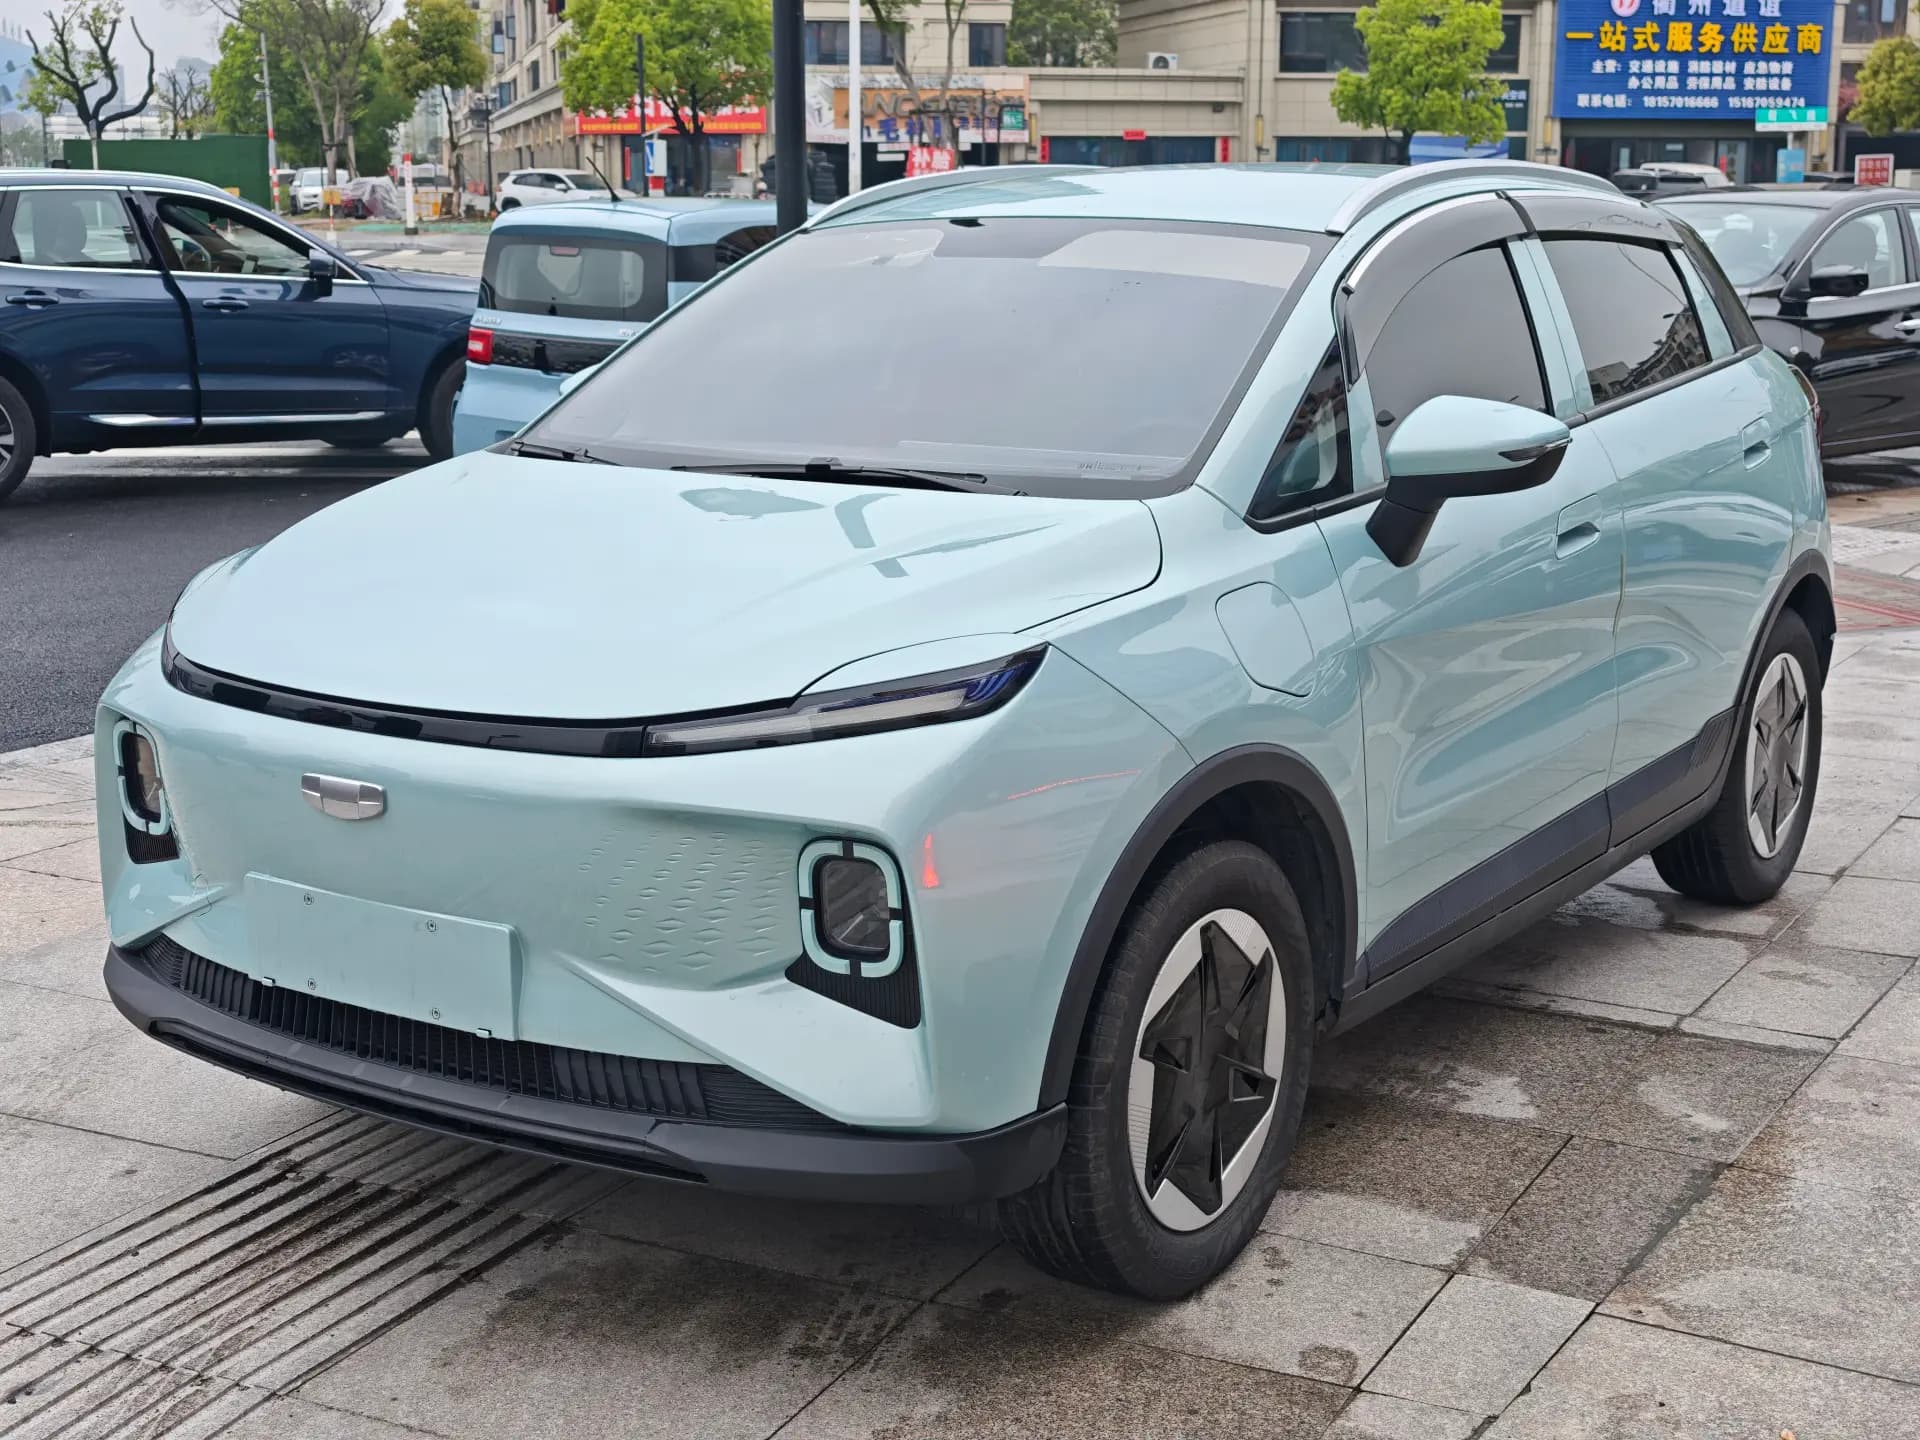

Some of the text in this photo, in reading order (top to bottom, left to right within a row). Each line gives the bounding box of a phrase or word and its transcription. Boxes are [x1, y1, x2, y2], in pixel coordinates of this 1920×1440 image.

[1566, 21, 1824, 54] 一站式服务供应商
